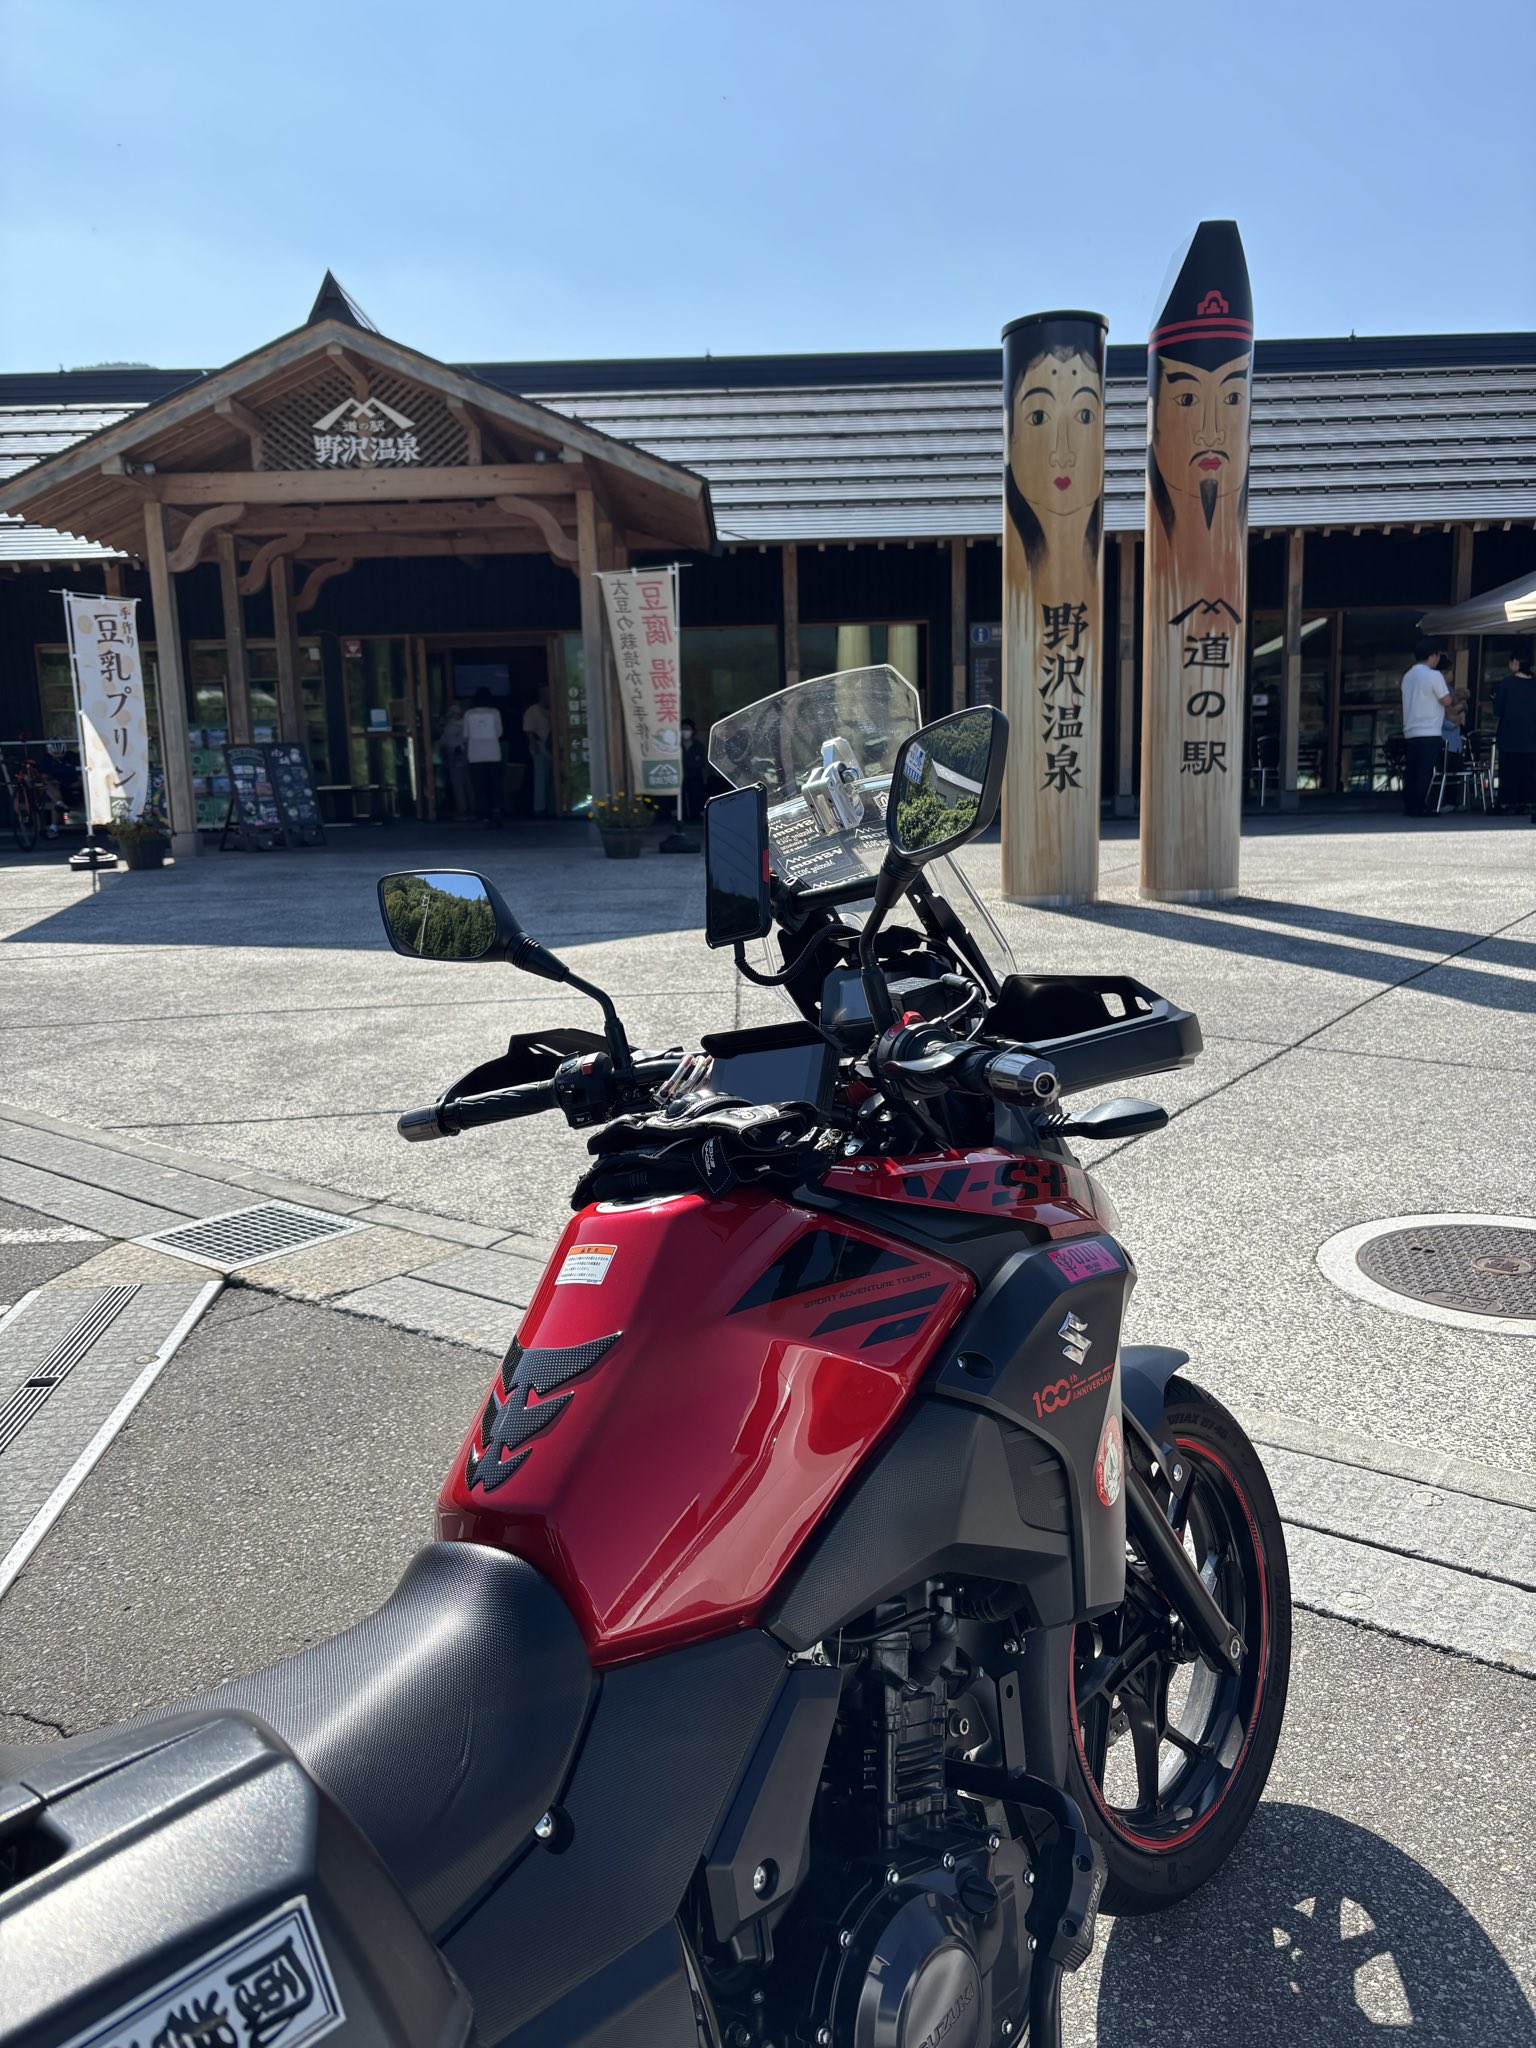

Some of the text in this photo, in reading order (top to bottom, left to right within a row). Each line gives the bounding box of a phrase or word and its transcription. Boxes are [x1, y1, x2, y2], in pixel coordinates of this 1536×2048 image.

[342, 420, 386, 433] 道の駅
[313, 432, 422, 465] 野沢温泉
[119, 606, 135, 649] 手作り
[93, 613, 136, 788] 豆乳プリン
[1038, 601, 1089, 794] 野沢温泉
[1180, 634, 1230, 776] 道の駅
[804, 1271, 932, 1310] SPORT ADVENTURE TOURER
